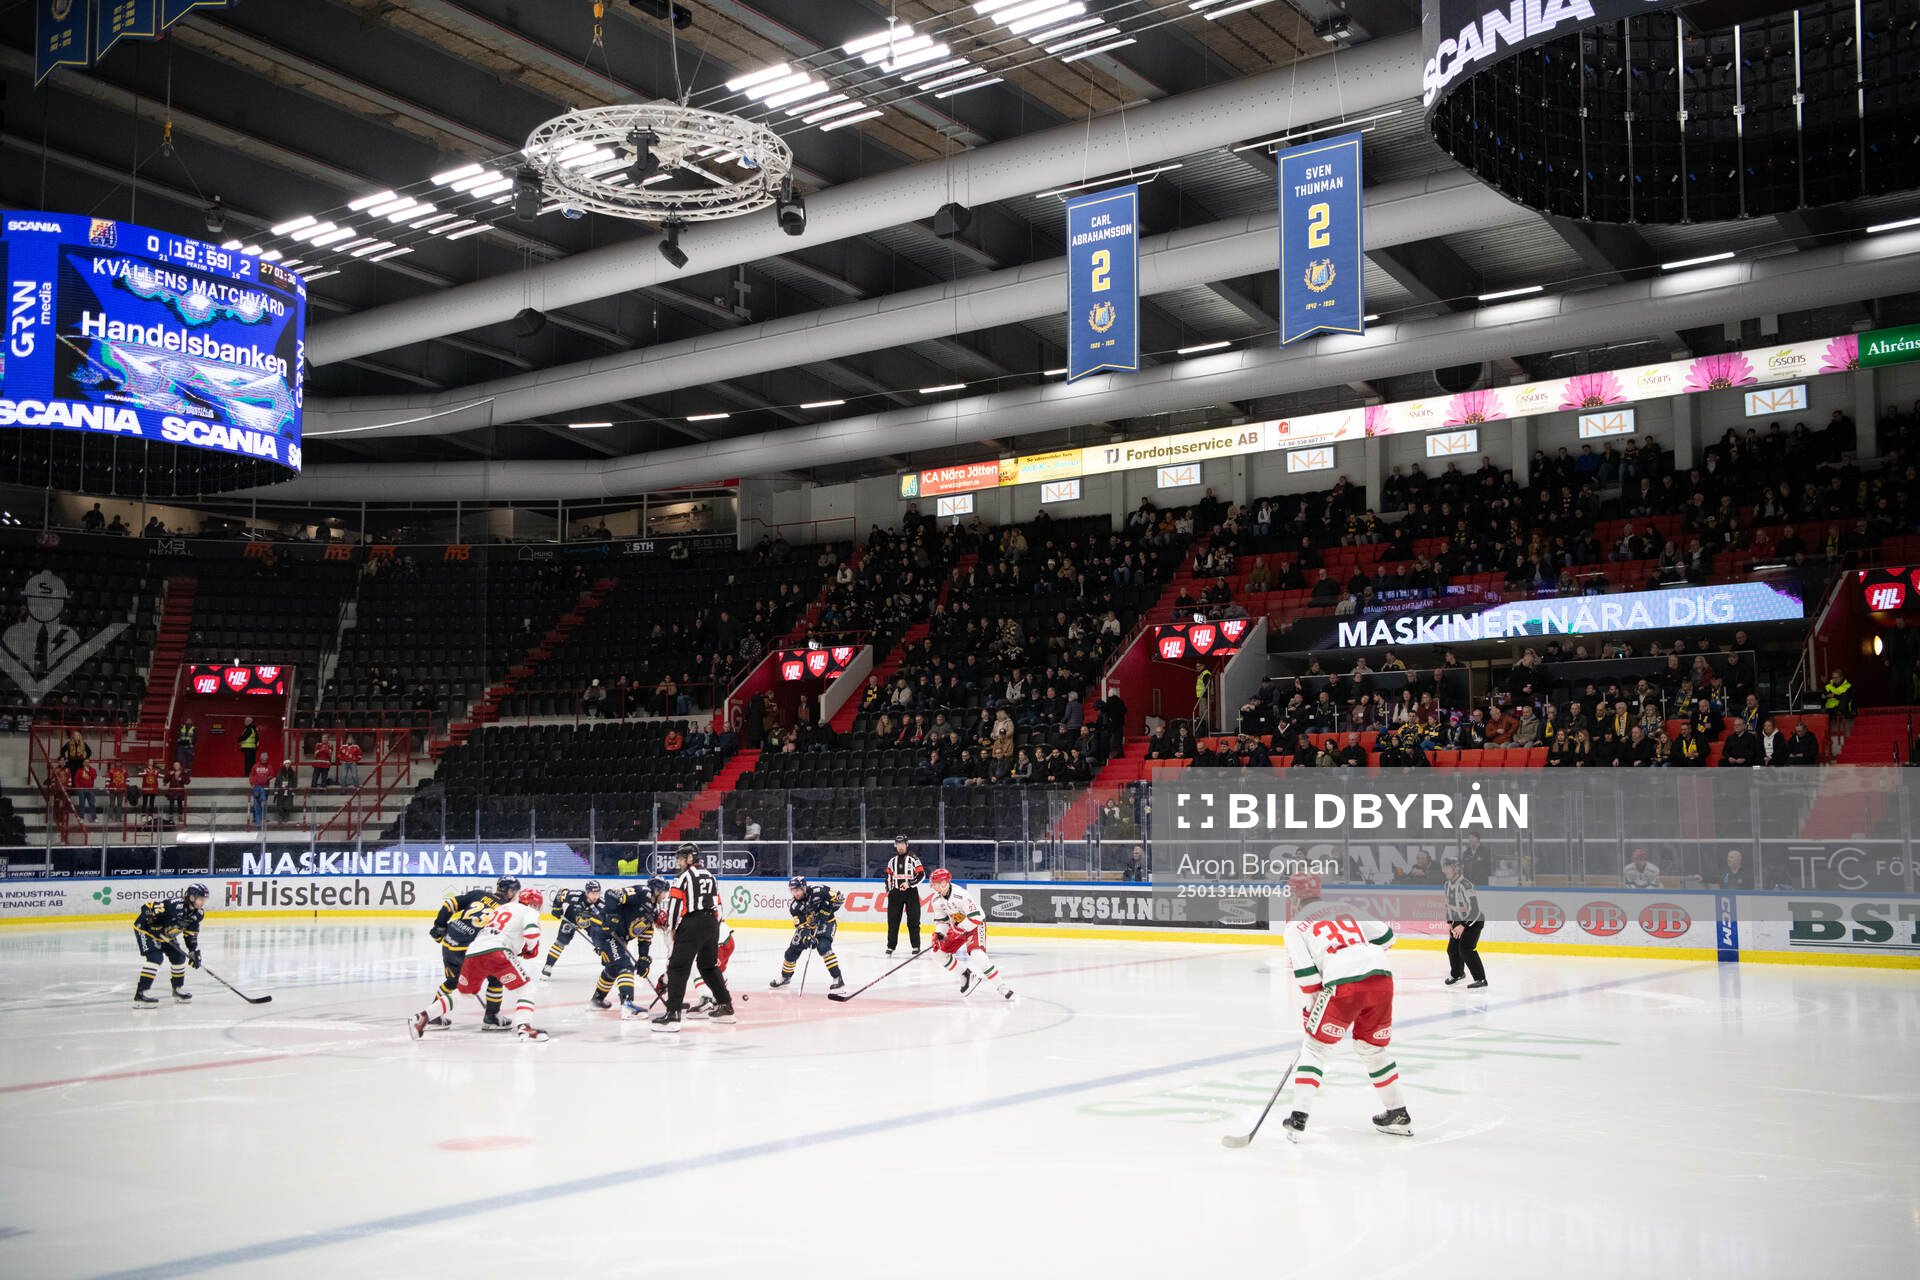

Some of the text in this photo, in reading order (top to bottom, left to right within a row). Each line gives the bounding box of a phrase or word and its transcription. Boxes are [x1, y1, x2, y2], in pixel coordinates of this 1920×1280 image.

[1422, 0, 1596, 107] SCANIA
[1305, 164, 1332, 180] SVEN
[1294, 176, 1344, 198] THUNMAN
[7, 220, 62, 233] SCANIA
[1091, 213, 1112, 229] CARL
[1308, 202, 1330, 249] 2
[147, 235, 160, 252] 0
[1071, 223, 1132, 246] ABRAHAMSSON
[174, 242, 228, 268] 19:59
[202, 243, 216, 251] TIME
[240, 259, 251, 275] 2
[260, 262, 273, 275] 27
[1091, 249, 1111, 293] 2
[92, 257, 285, 317] KVÄLLENS MATCHVÄRD
[40, 282, 52, 325] media
[81, 311, 288, 377] Handelsbanken
[1752, 388, 1799, 413] N4
[0, 400, 143, 435] SCANIA
[1584, 413, 1627, 436] N4
[161, 416, 279, 460] SCANIA
[1104, 432, 1259, 464] TJ Fordonsservice AB
[1431, 432, 1471, 455] N4
[1291, 450, 1328, 469] N4
[922, 472, 939, 484] ICA
[941, 469, 965, 481] Nära
[967, 465, 998, 478] Jätten
[1161, 466, 1195, 486] N4
[1044, 481, 1075, 501] N4
[941, 497, 969, 515] N4
[632, 542, 654, 551] STH
[39, 583, 53, 594] S
[1337, 592, 1735, 648] MASKINER NÄRA DIG
[242, 844, 548, 876] MASKINER NÄRA DIG
[655, 852, 748, 870] Bjös Resor
[6, 890, 67, 899] INDUSTRIAL
[247, 879, 370, 906] Hisstech
[379, 880, 416, 906] AB
[699, 879, 713, 894] 27
[48, 899, 63, 907] AB
[1051, 895, 1187, 921] TYSSLINGE
[1520, 904, 1563, 929] JB
[1581, 906, 1623, 932] JB
[1641, 907, 1688, 933] JB
[1720, 896, 1733, 947] CCM
[1312, 913, 1366, 954] 39
